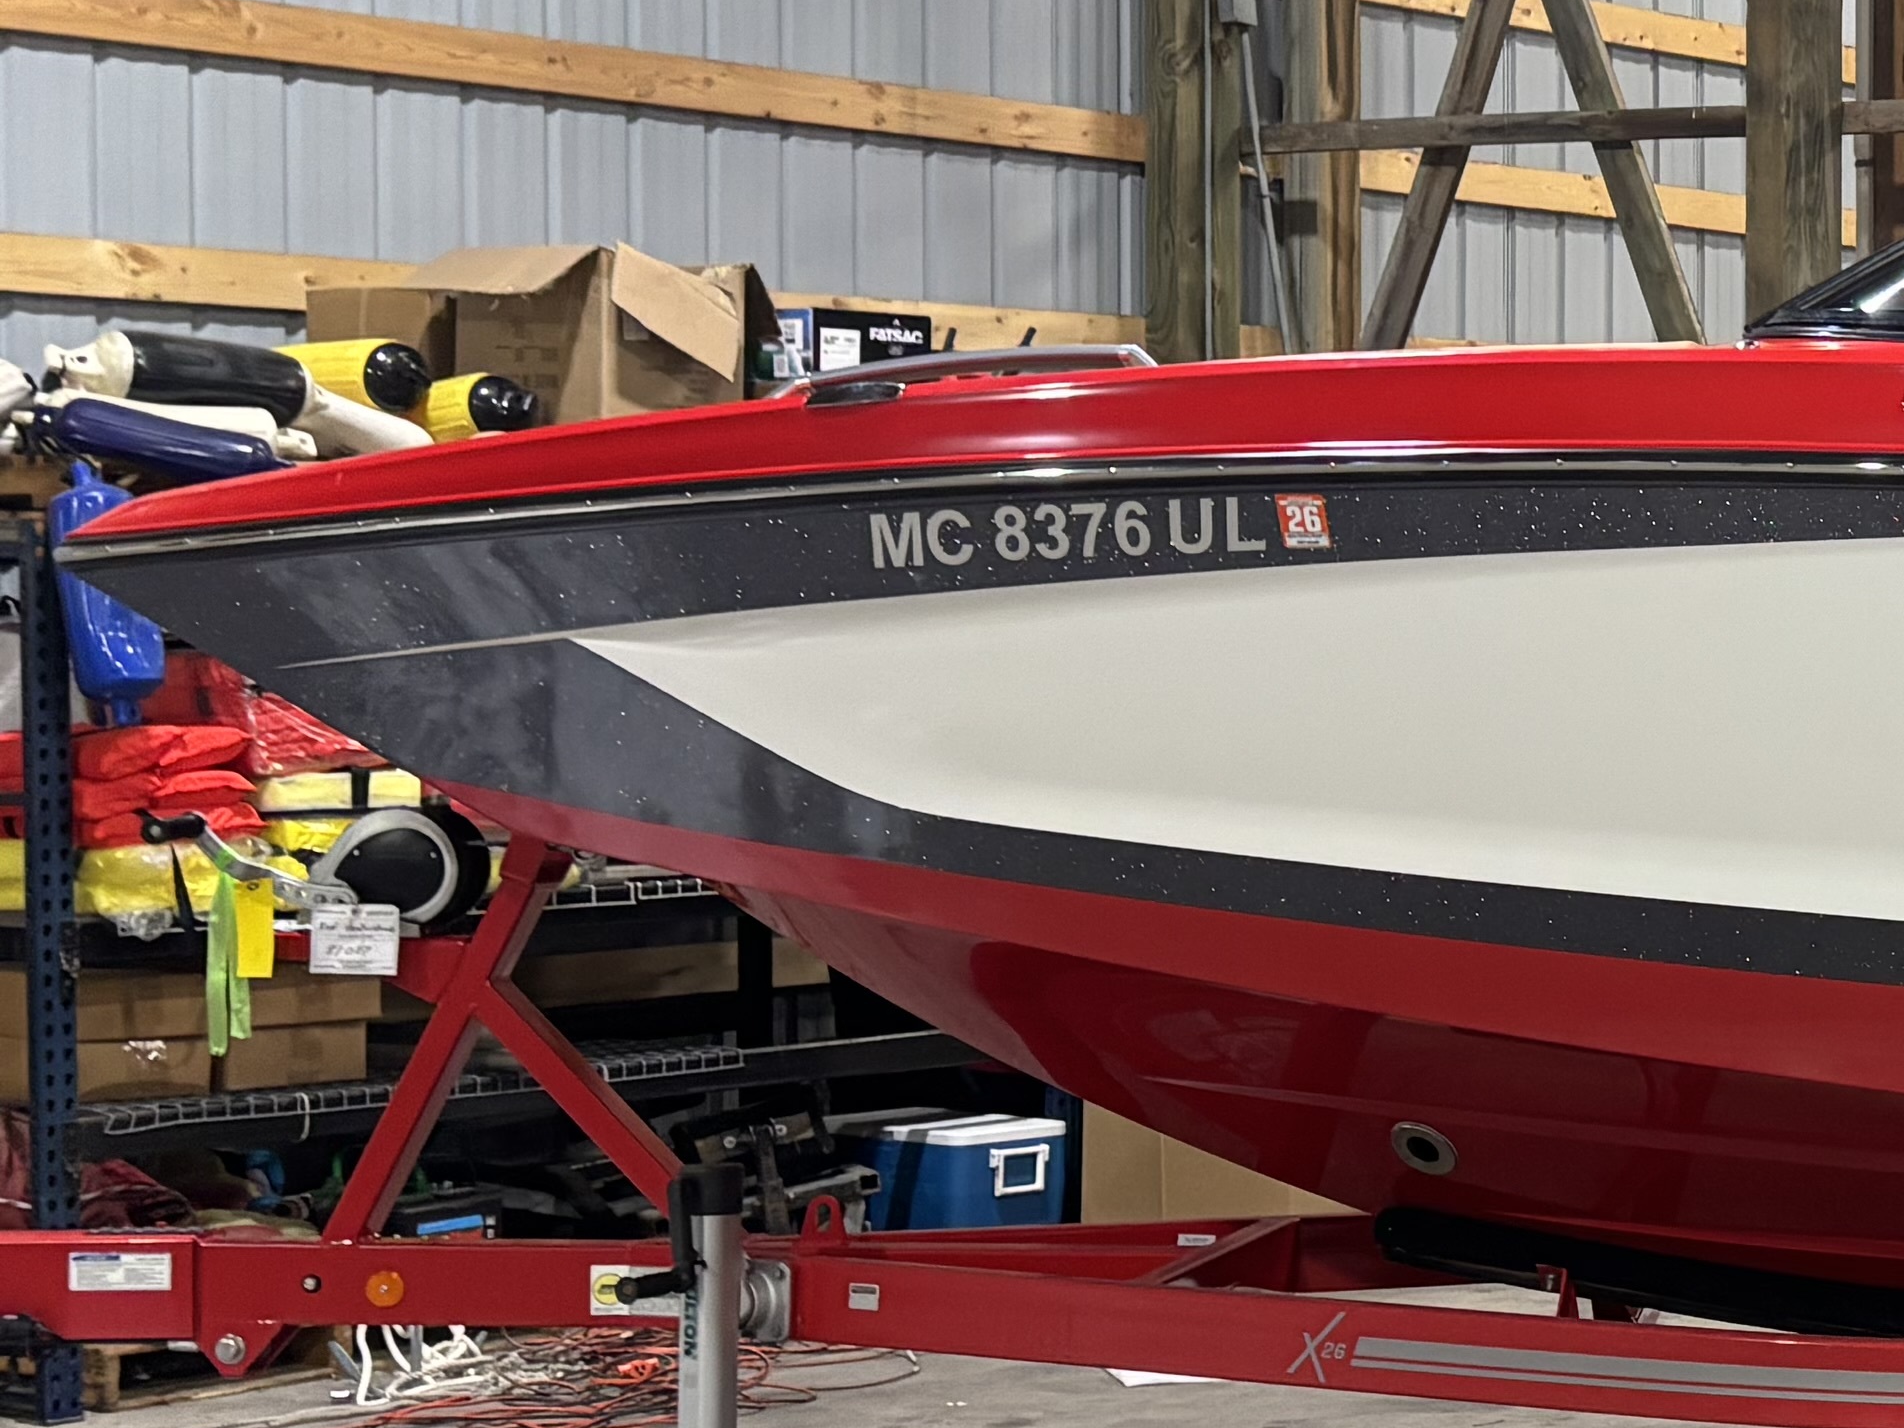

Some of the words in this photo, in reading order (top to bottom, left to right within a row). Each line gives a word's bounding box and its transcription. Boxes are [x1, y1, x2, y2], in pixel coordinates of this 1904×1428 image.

[869, 508, 974, 570] MC
[993, 501, 1152, 562] 8376
[1168, 496, 1266, 555] UL
[1286, 505, 1322, 533] 26
[684, 1288, 698, 1357] ULTON
